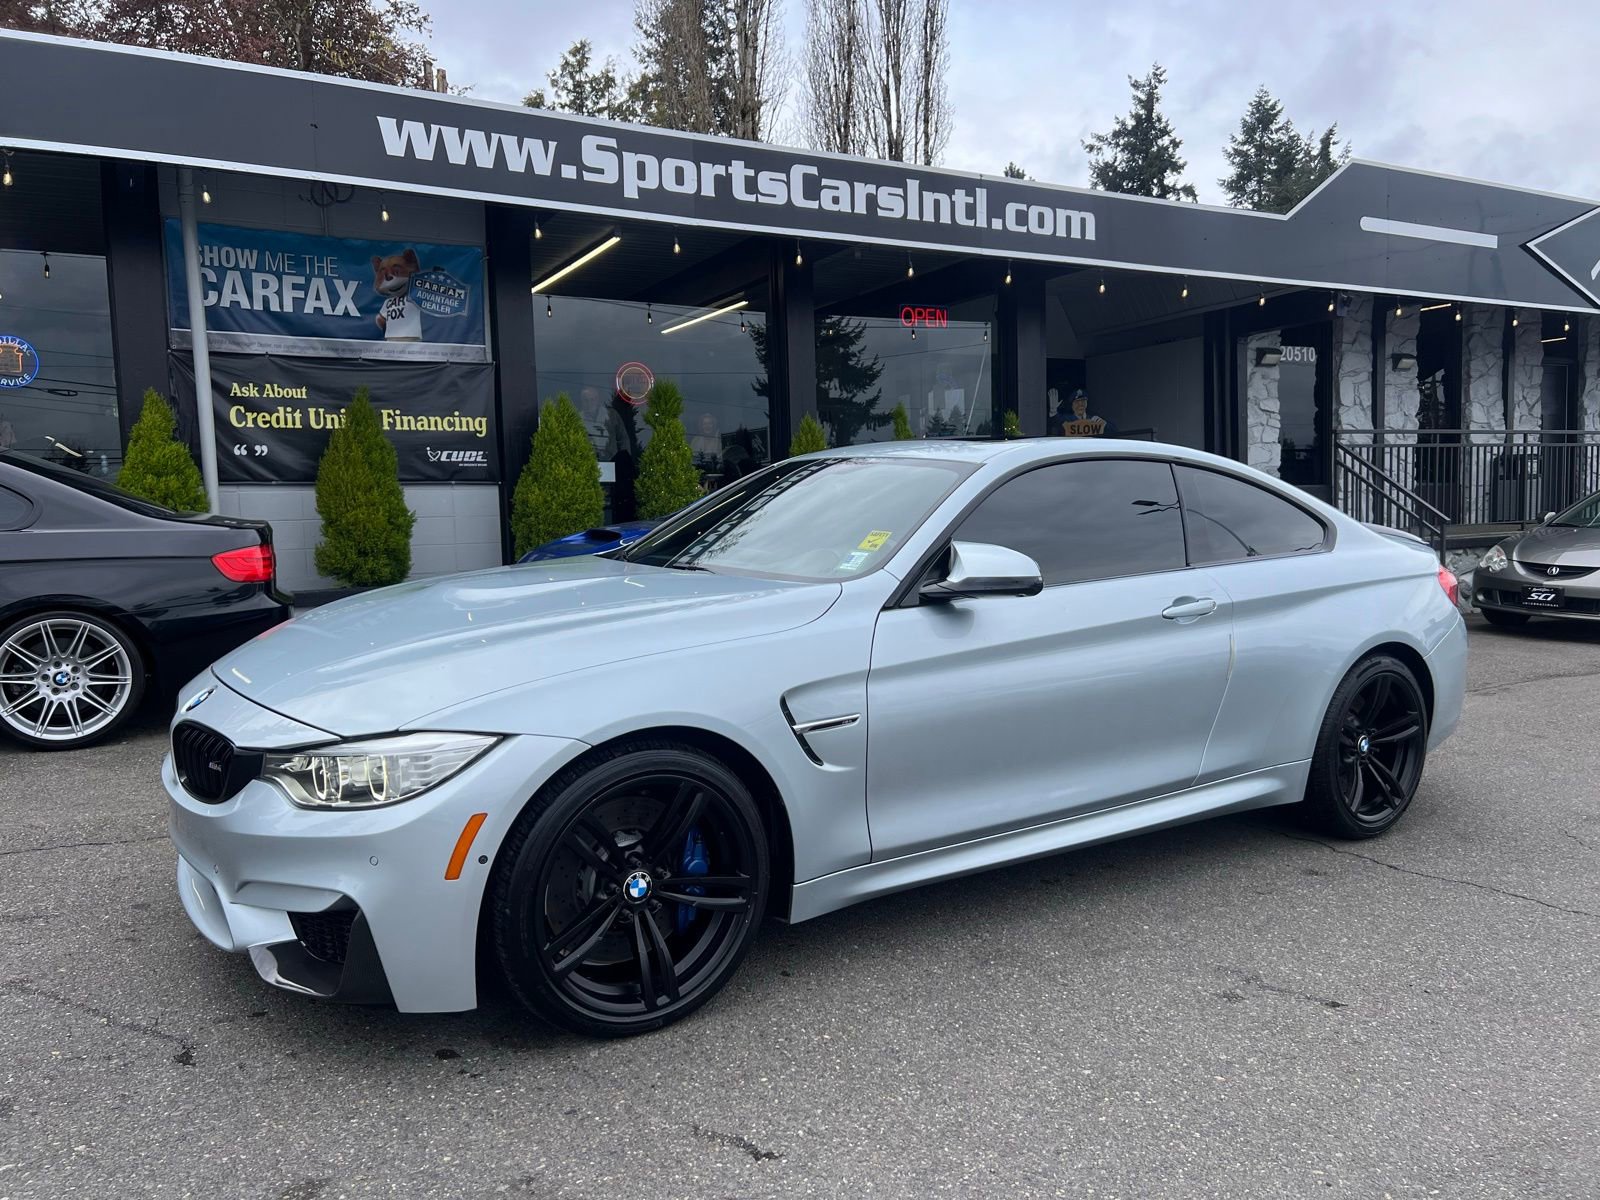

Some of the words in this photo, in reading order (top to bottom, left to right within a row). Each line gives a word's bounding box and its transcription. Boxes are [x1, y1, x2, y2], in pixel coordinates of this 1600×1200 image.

[265, 250, 296, 273] ME
[302, 254, 338, 277] THE
[200, 266, 361, 317] CARFAX
[415, 280, 465, 299] CARFAX
[416, 290, 460, 308] ADVANTAGE
[421, 301, 451, 314] DEALER
[386, 308, 405, 321] FOX
[901, 306, 947, 328] OPEN
[0, 336, 32, 356] ILLAC
[1280, 346, 1316, 361] 20510
[230, 383, 260, 397] Ask
[263, 383, 307, 399] About
[229, 405, 302, 429] Credit
[307, 407, 347, 430] Uni
[381, 409, 487, 438] Financing
[1070, 424, 1102, 435] SLOW
[1528, 593, 1555, 601] SCI
